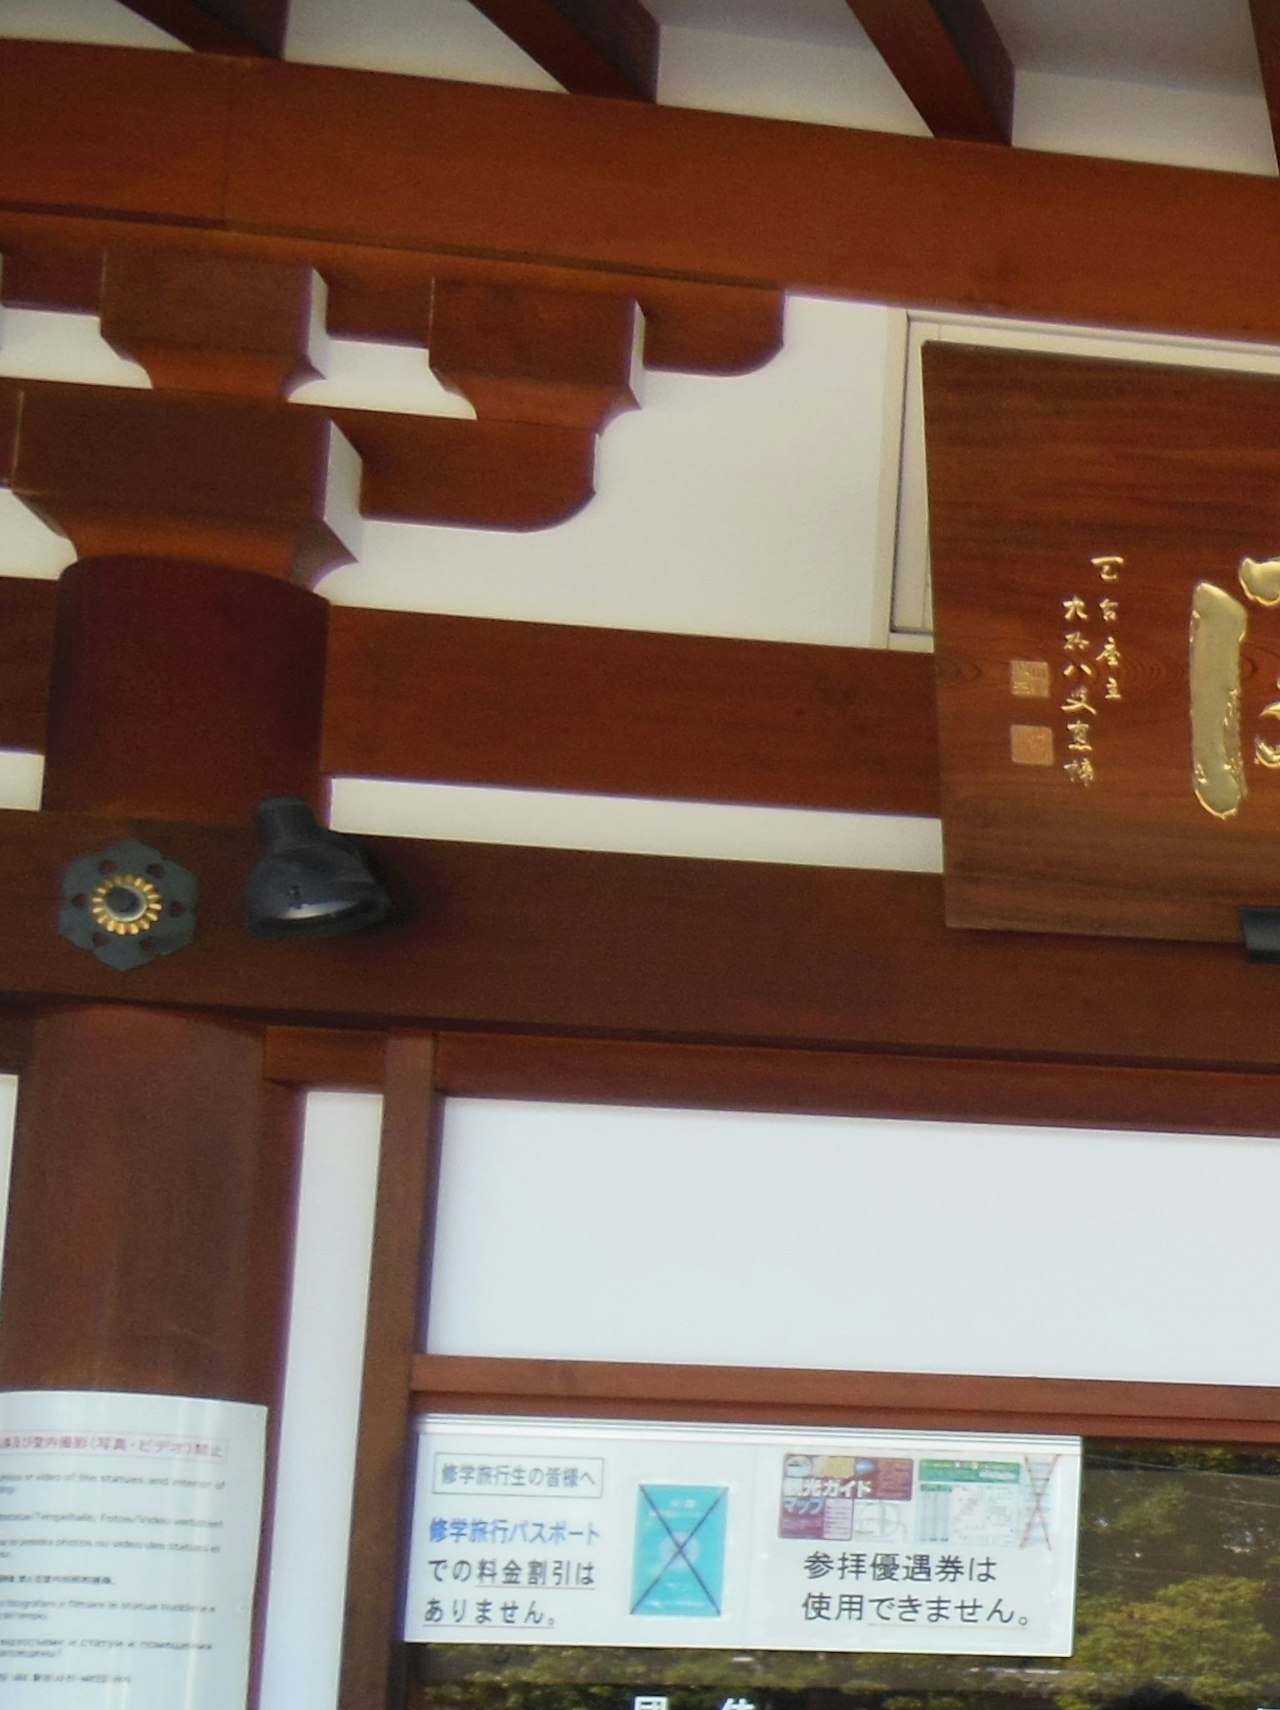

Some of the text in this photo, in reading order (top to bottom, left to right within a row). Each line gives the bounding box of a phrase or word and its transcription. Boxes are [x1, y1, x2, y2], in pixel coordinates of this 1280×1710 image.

[441, 1463, 596, 1488] 修学旅行生の皆様へ
[429, 1517, 600, 1544] 修学旅行パスポート
[428, 1558, 595, 1586] での料金割引は
[803, 1550, 997, 1583] 参拝優遇券は
[424, 1598, 555, 1626] ありません。
[801, 1591, 1028, 1627] 使用できません。
